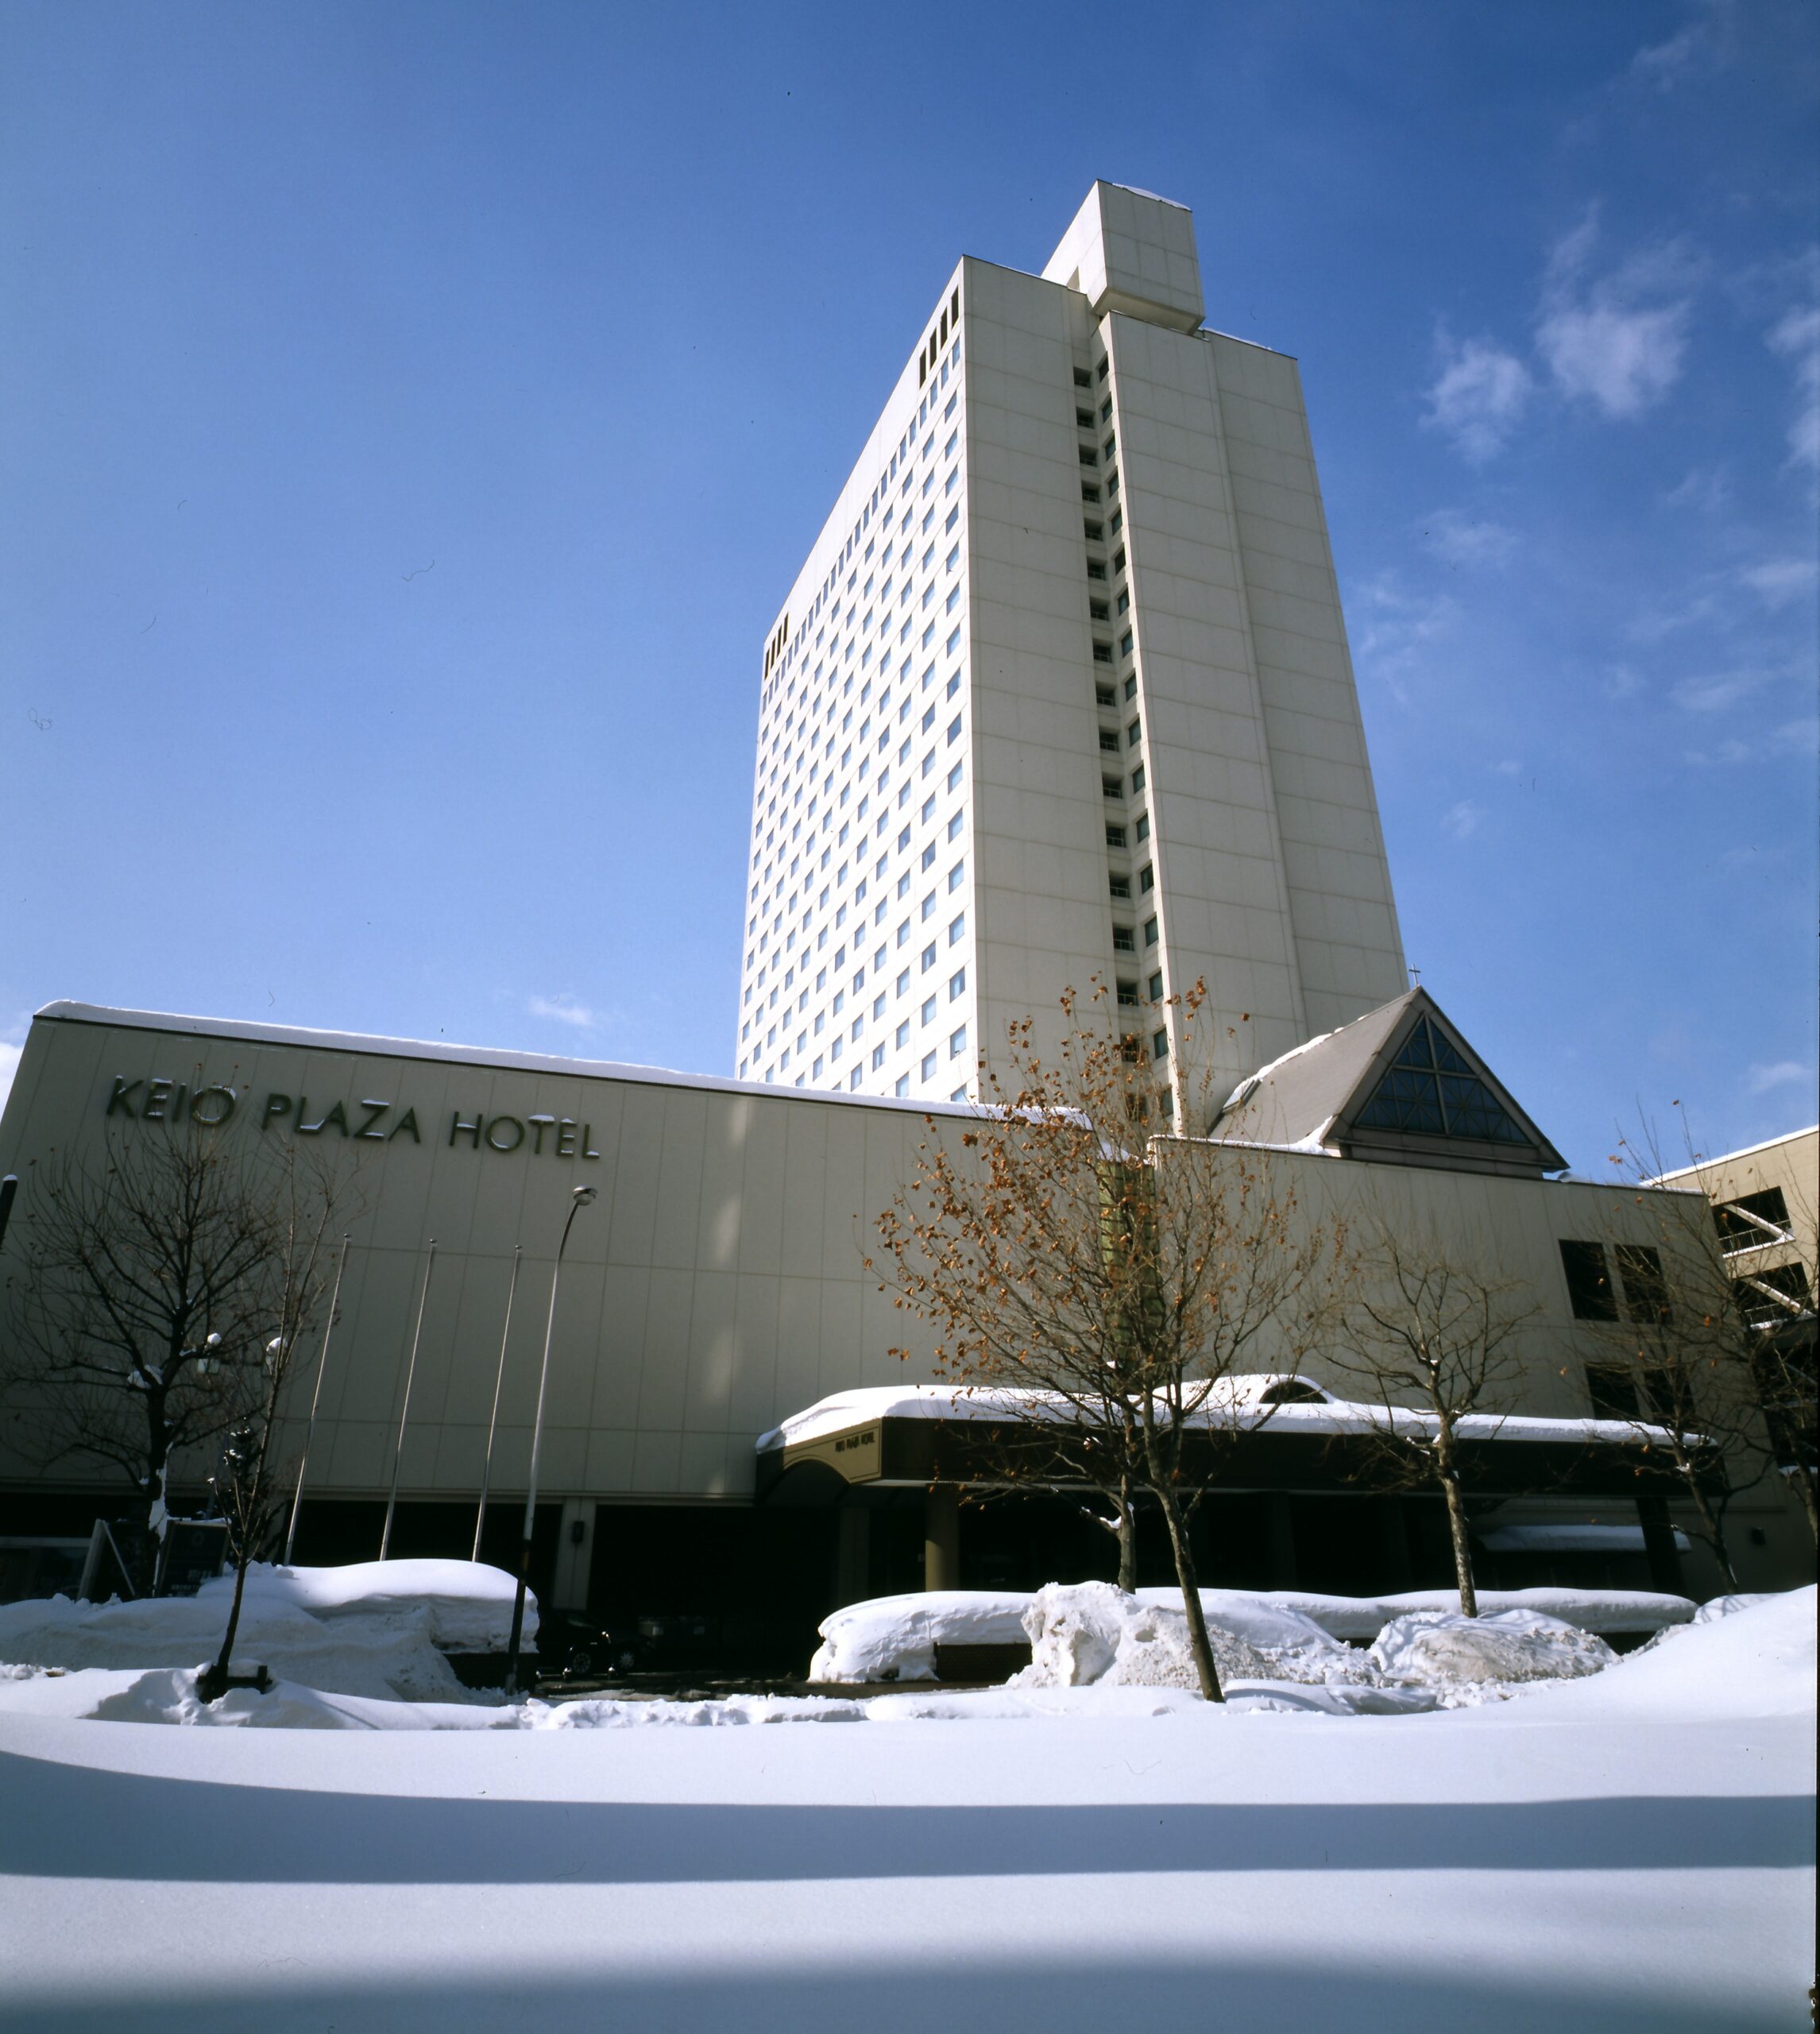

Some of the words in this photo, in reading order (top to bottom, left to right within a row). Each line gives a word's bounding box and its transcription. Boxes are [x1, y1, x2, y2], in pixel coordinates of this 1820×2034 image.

[106, 1075, 237, 1125] KEIO
[261, 1093, 421, 1143] PLAZA
[449, 1111, 600, 1158] HOTEL
